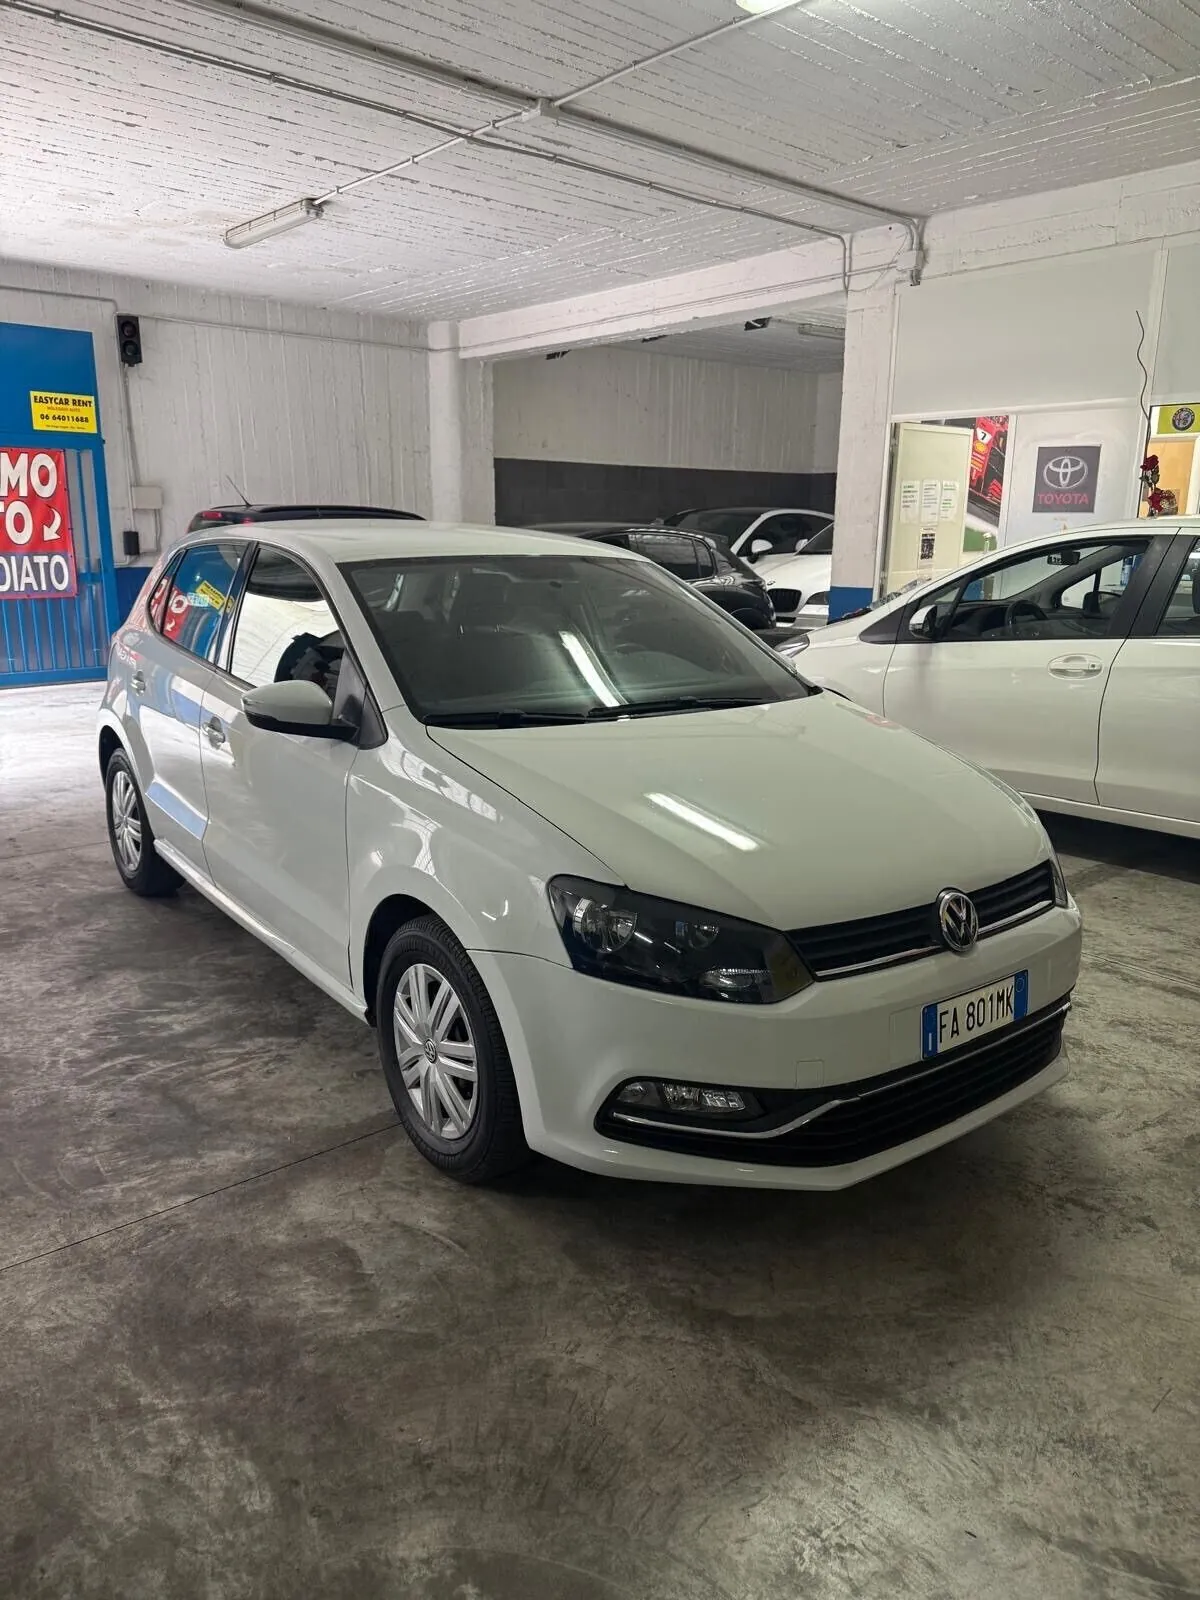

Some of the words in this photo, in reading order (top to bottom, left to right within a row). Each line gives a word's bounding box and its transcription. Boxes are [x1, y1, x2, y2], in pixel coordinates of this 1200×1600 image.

[34, 395, 69, 406] EASYCAR
[72, 399, 92, 407] RENT
[0, 452, 58, 498] MO
[1038, 493, 1089, 505] TOYOTA
[0, 500, 34, 545] O
[939, 1007, 960, 1043] FA
[966, 985, 1014, 1031] 801MK
